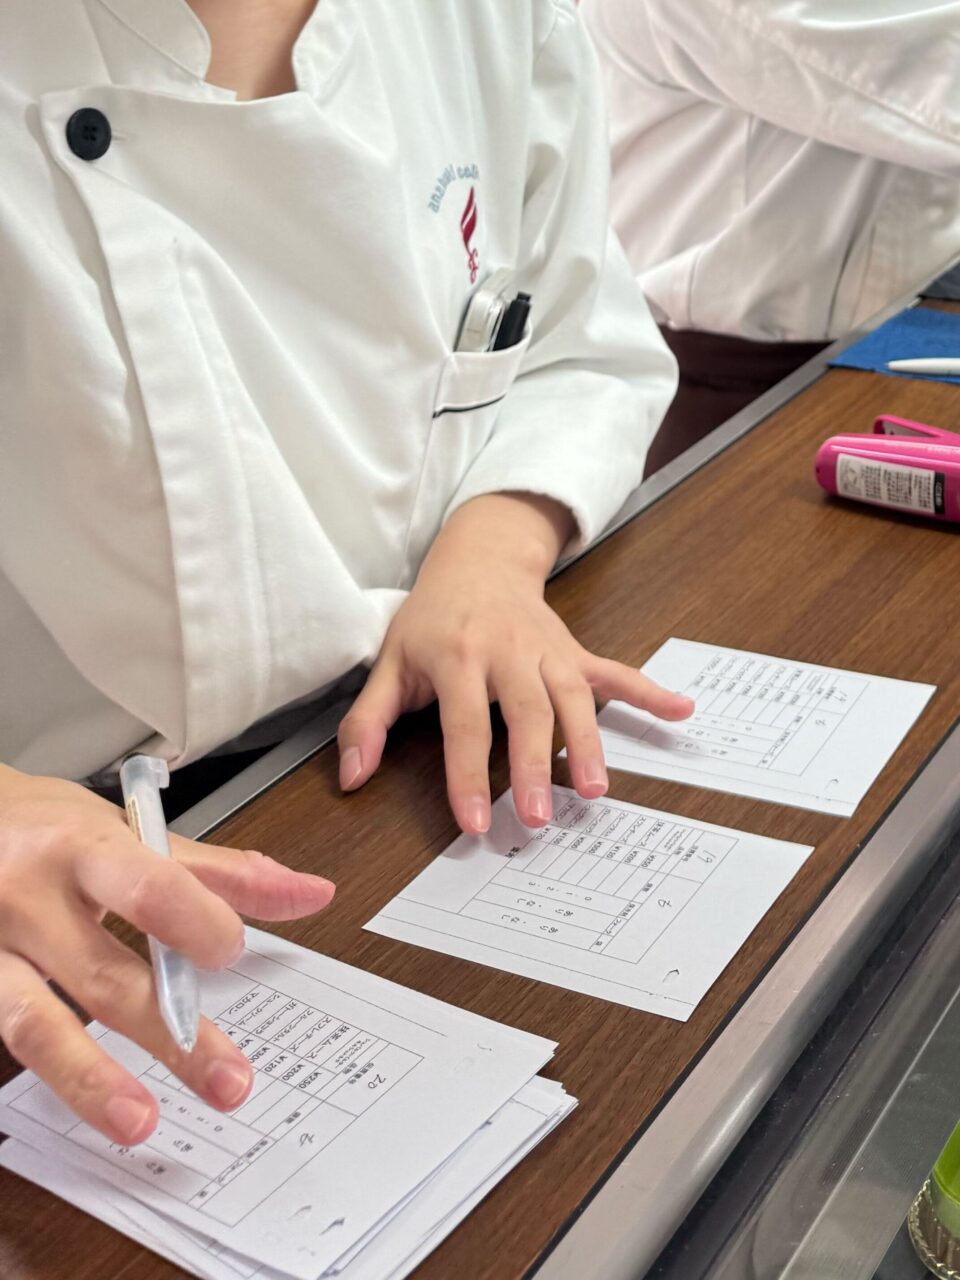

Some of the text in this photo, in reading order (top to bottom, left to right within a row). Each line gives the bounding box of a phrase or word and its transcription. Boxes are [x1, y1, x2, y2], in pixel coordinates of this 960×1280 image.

[536, 828, 550, 840] ¥120
[606, 846, 620, 859] ¥120
[624, 851, 638, 864] ¥200
[229, 993, 259, 1015] マカロン
[238, 994, 280, 1025] シュークリーム
[256, 1002, 297, 1034] ガトーショコラ
[273, 1010, 314, 1042] フルーツタルト
[289, 1017, 332, 1052] スフレチーズ
[307, 1026, 350, 1059] 抹茶ムース
[264, 1056, 288, 1072] ¥120
[282, 1064, 304, 1081] ¥200
[298, 1072, 322, 1089] ¥250
[368, 1074, 386, 1089] 20
